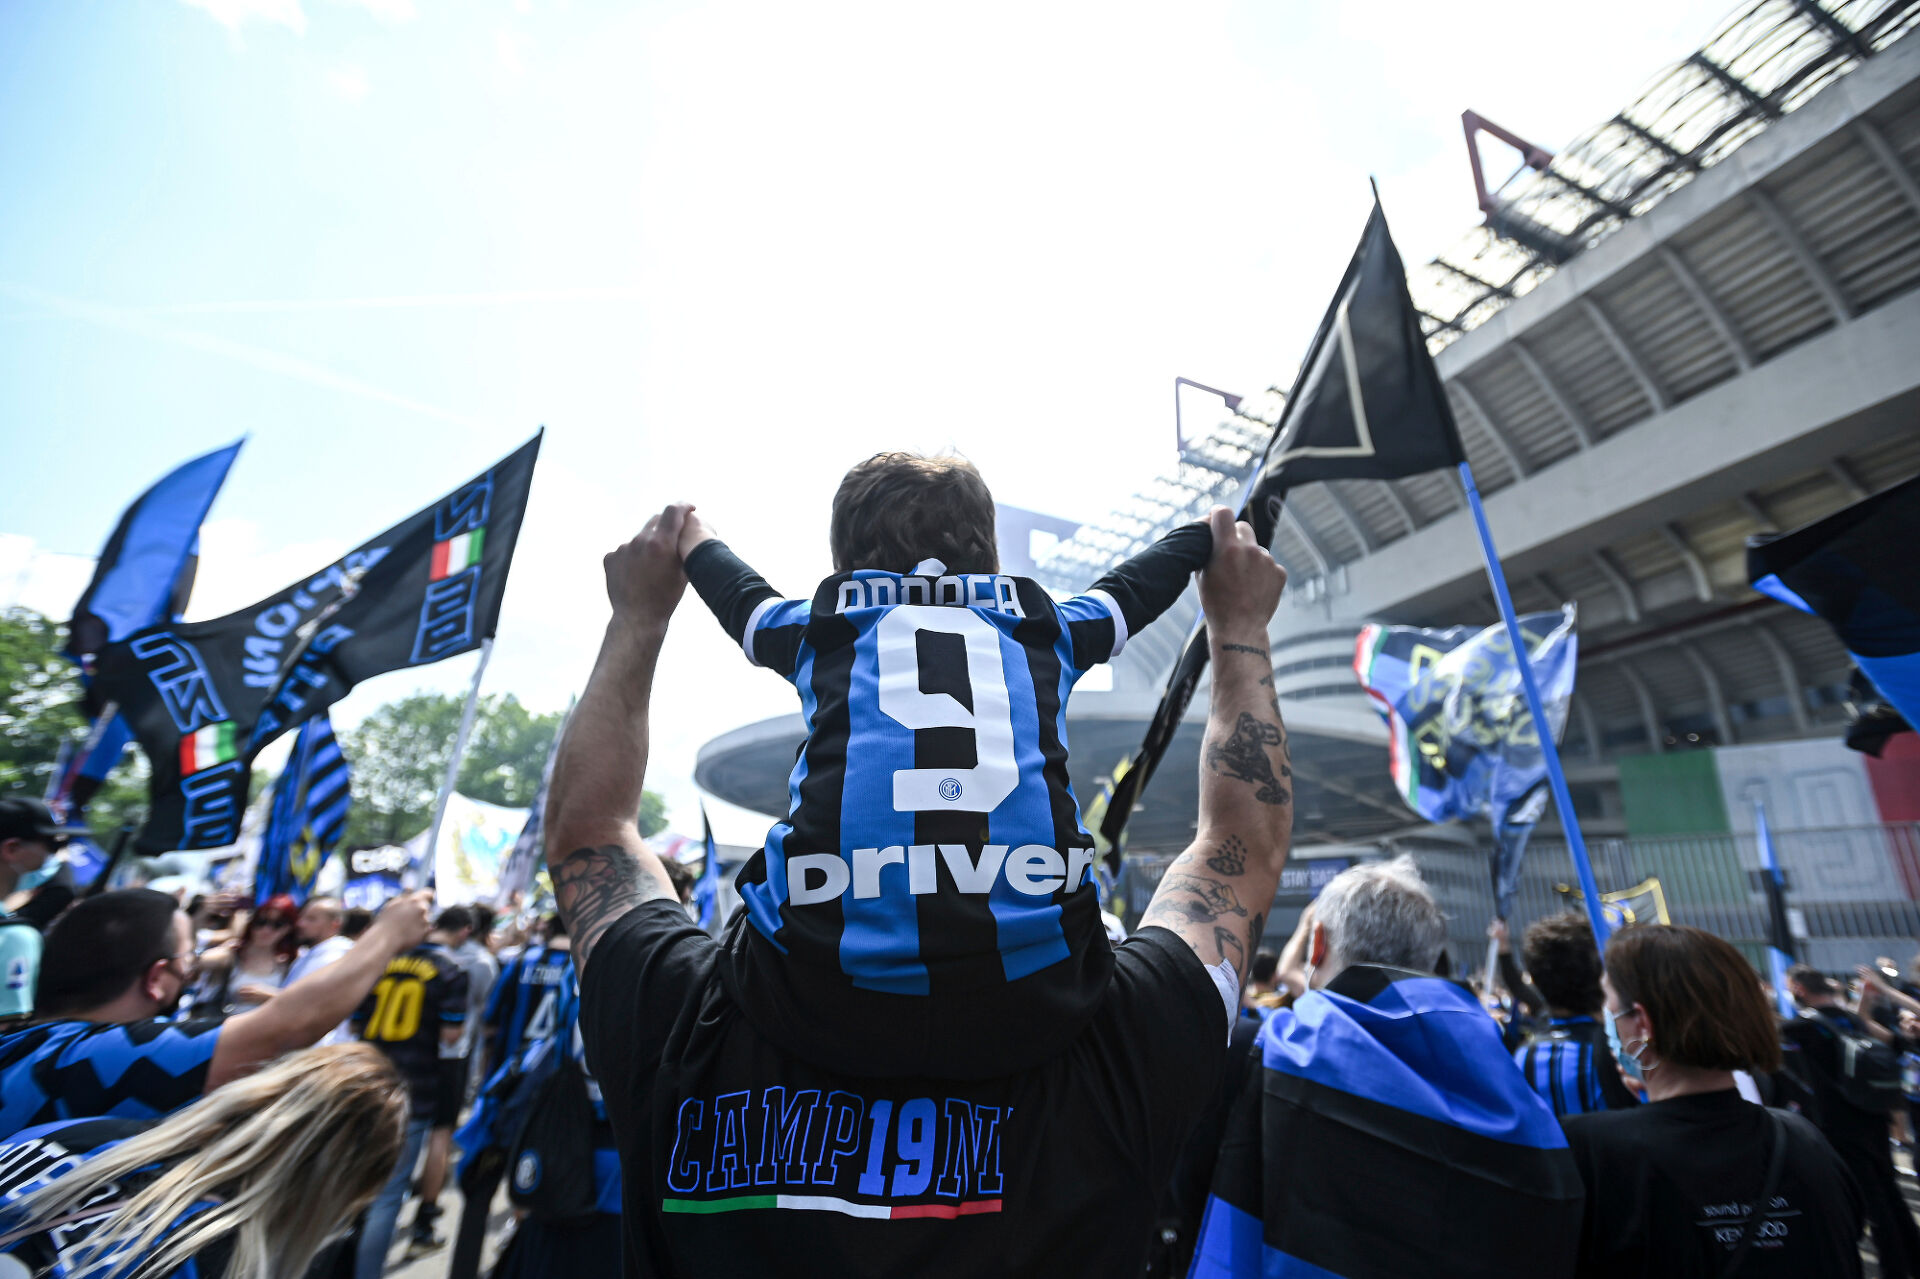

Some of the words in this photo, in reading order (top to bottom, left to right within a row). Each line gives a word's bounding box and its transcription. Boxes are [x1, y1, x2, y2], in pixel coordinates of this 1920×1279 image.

[877, 604, 1018, 812] 9
[787, 844, 1095, 906] Driver
[364, 977, 425, 1042] 10
[667, 1086, 1014, 1198] CAMP19N
